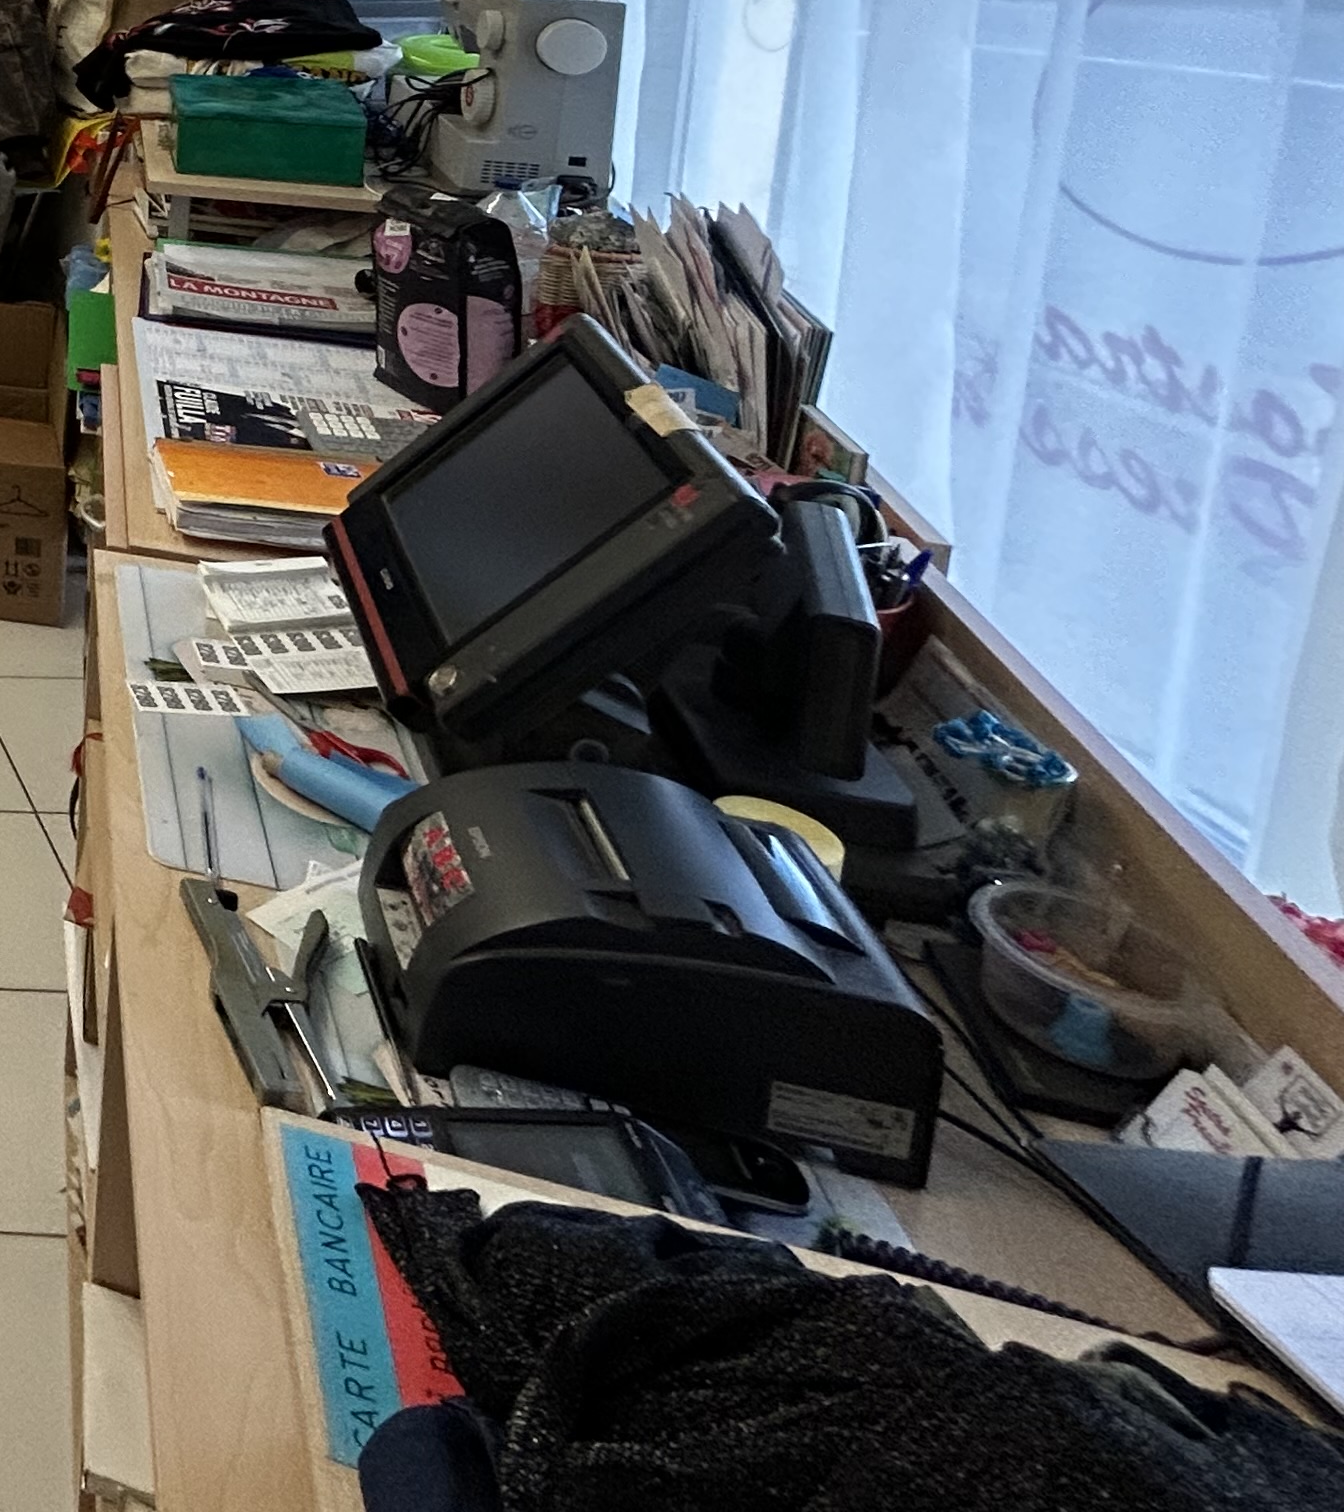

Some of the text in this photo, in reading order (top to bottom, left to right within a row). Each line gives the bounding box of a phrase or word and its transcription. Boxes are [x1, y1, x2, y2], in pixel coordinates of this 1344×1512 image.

[169, 278, 333, 309] LA MONTAGNE
[173, 385, 207, 424] FUILLA
[303, 1144, 376, 1449] CARTE BANCAIRE
